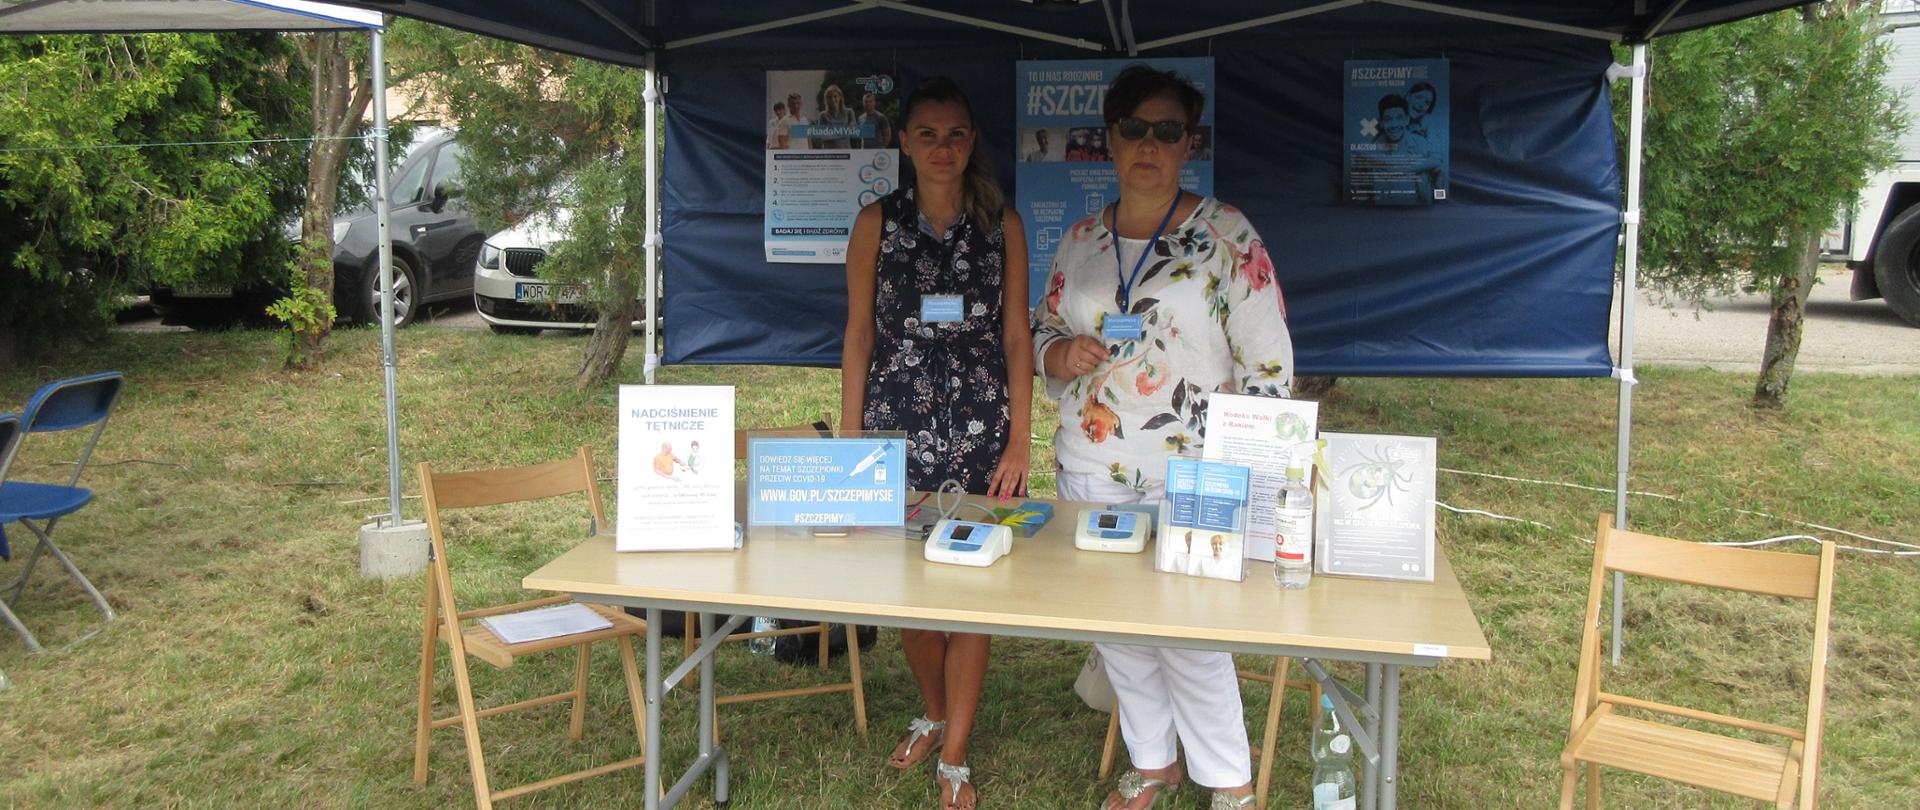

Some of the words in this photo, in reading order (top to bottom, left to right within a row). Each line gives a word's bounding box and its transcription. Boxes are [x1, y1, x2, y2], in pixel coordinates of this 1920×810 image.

[1028, 71, 1038, 81] TO
[1039, 71, 1044, 81] U
[1046, 71, 1061, 81] NAS
[1027, 84, 1110, 116] #SZCZE
[522, 285, 543, 298] WOR
[631, 406, 719, 418] NADCIŚNIENIE
[645, 421, 705, 433] TĘTNICZE
[759, 455, 793, 464] DOWIEDZ
[794, 455, 805, 465] SIĘ
[806, 455, 832, 465] WIĘCEJ
[759, 465, 770, 473] NA
[772, 465, 796, 473] TEMAT
[798, 465, 844, 473] SZCZEPIONKI
[792, 475, 826, 483] COVID-19
[760, 489, 894, 502] WWW.GOV.PL/SZCZEPIMYSIE
